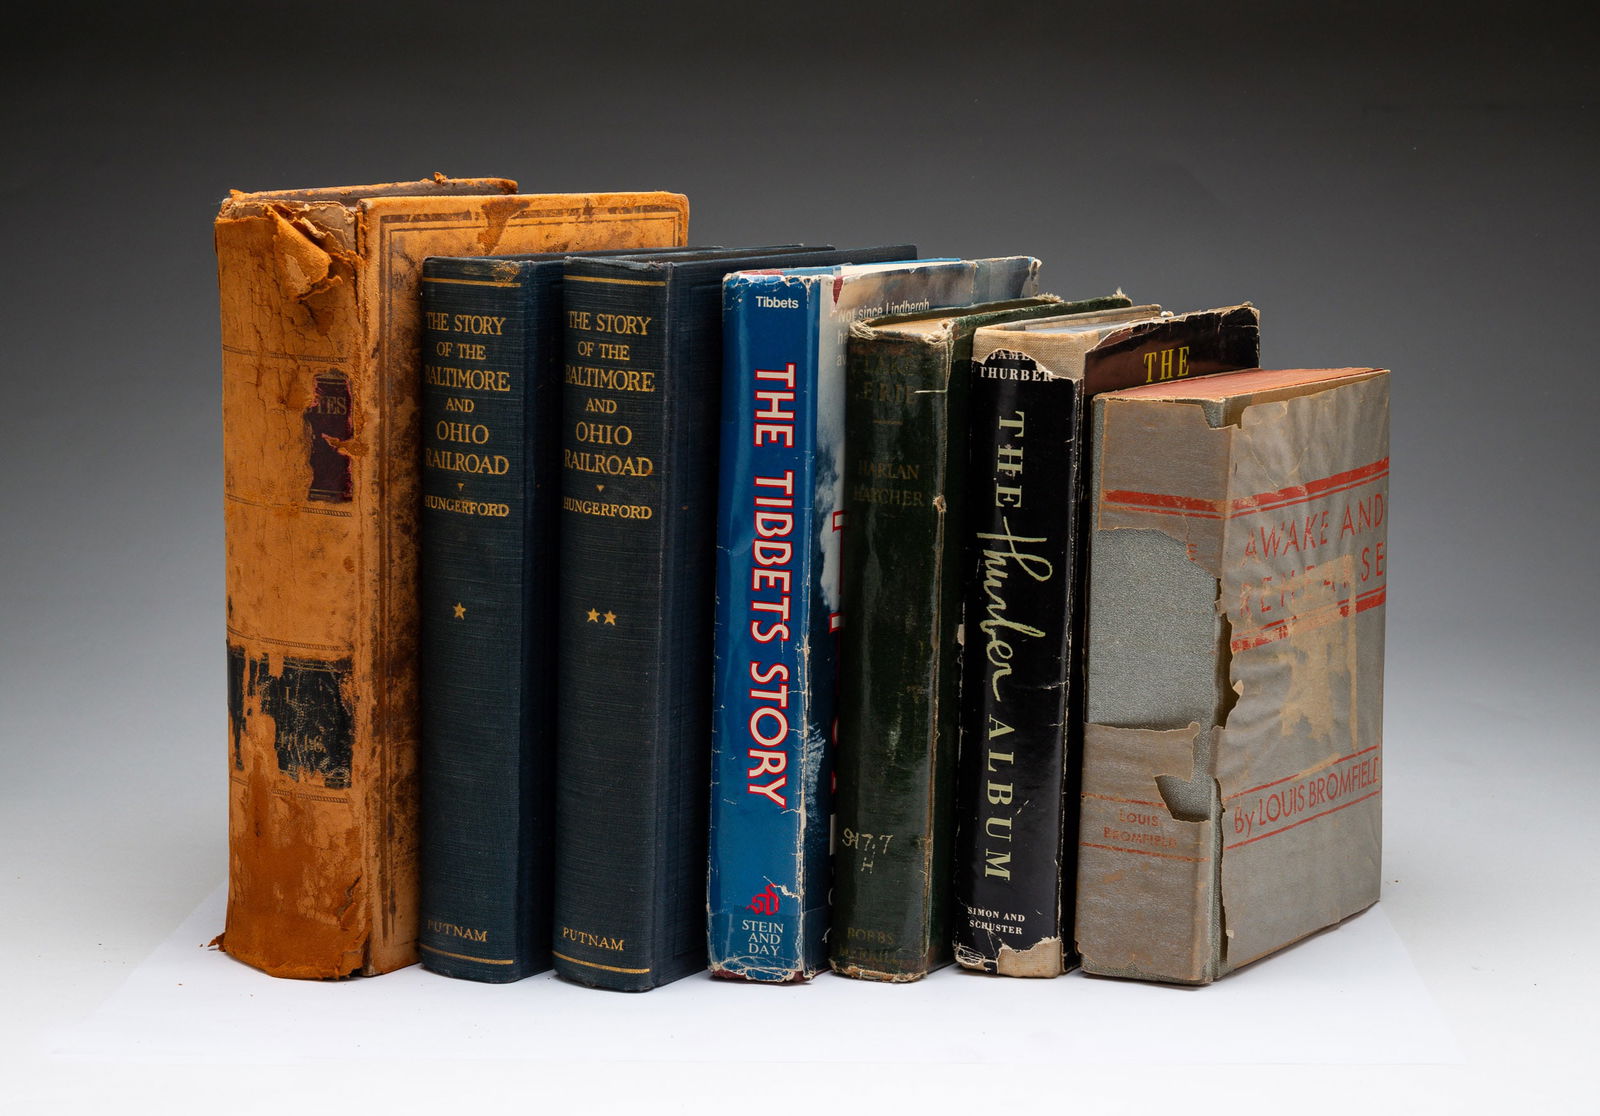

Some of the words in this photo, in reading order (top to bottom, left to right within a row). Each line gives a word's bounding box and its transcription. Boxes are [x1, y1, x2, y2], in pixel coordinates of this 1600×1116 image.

[755, 296, 799, 309] Tibbets
[858, 306, 883, 320] since
[425, 312, 449, 331] THE
[454, 314, 506, 335] STORY
[568, 311, 592, 330] THE
[596, 314, 652, 335] STORY
[436, 341, 453, 357] OF
[457, 343, 486, 360] THE
[577, 341, 594, 357] OF
[599, 343, 630, 360] THE
[980, 366, 1053, 382] THURBER
[1144, 345, 1190, 383] THE
[445, 397, 475, 412] AND
[585, 397, 618, 414] AND
[754, 362, 796, 448] THE
[436, 420, 489, 444] OHIO
[576, 421, 633, 446] OHIO
[425, 448, 510, 475] RAILROAD
[564, 448, 654, 476] RAILROAD
[995, 410, 1025, 509] THE
[425, 495, 510, 517] HUNGERFORD
[563, 496, 653, 519] HUNGERFORD
[1241, 510, 1329, 566] AWAKE
[1341, 493, 1384, 541] AND
[751, 470, 795, 643] TIBBETS
[976, 516, 1053, 702] Thurber
[748, 661, 789, 807] STORY
[984, 713, 1016, 881] ALBUM
[1119, 808, 1160, 827] LOUIS
[1234, 805, 1255, 838] By
[1258, 784, 1305, 826] LOUIS
[742, 919, 784, 934] STEIN
[968, 907, 999, 919] SIMON
[1003, 913, 1026, 923] AND
[562, 927, 625, 951] PUTNAM
[748, 932, 780, 945] AND
[969, 920, 1022, 935] SCHUSTER
[748, 943, 780, 957] DAY
